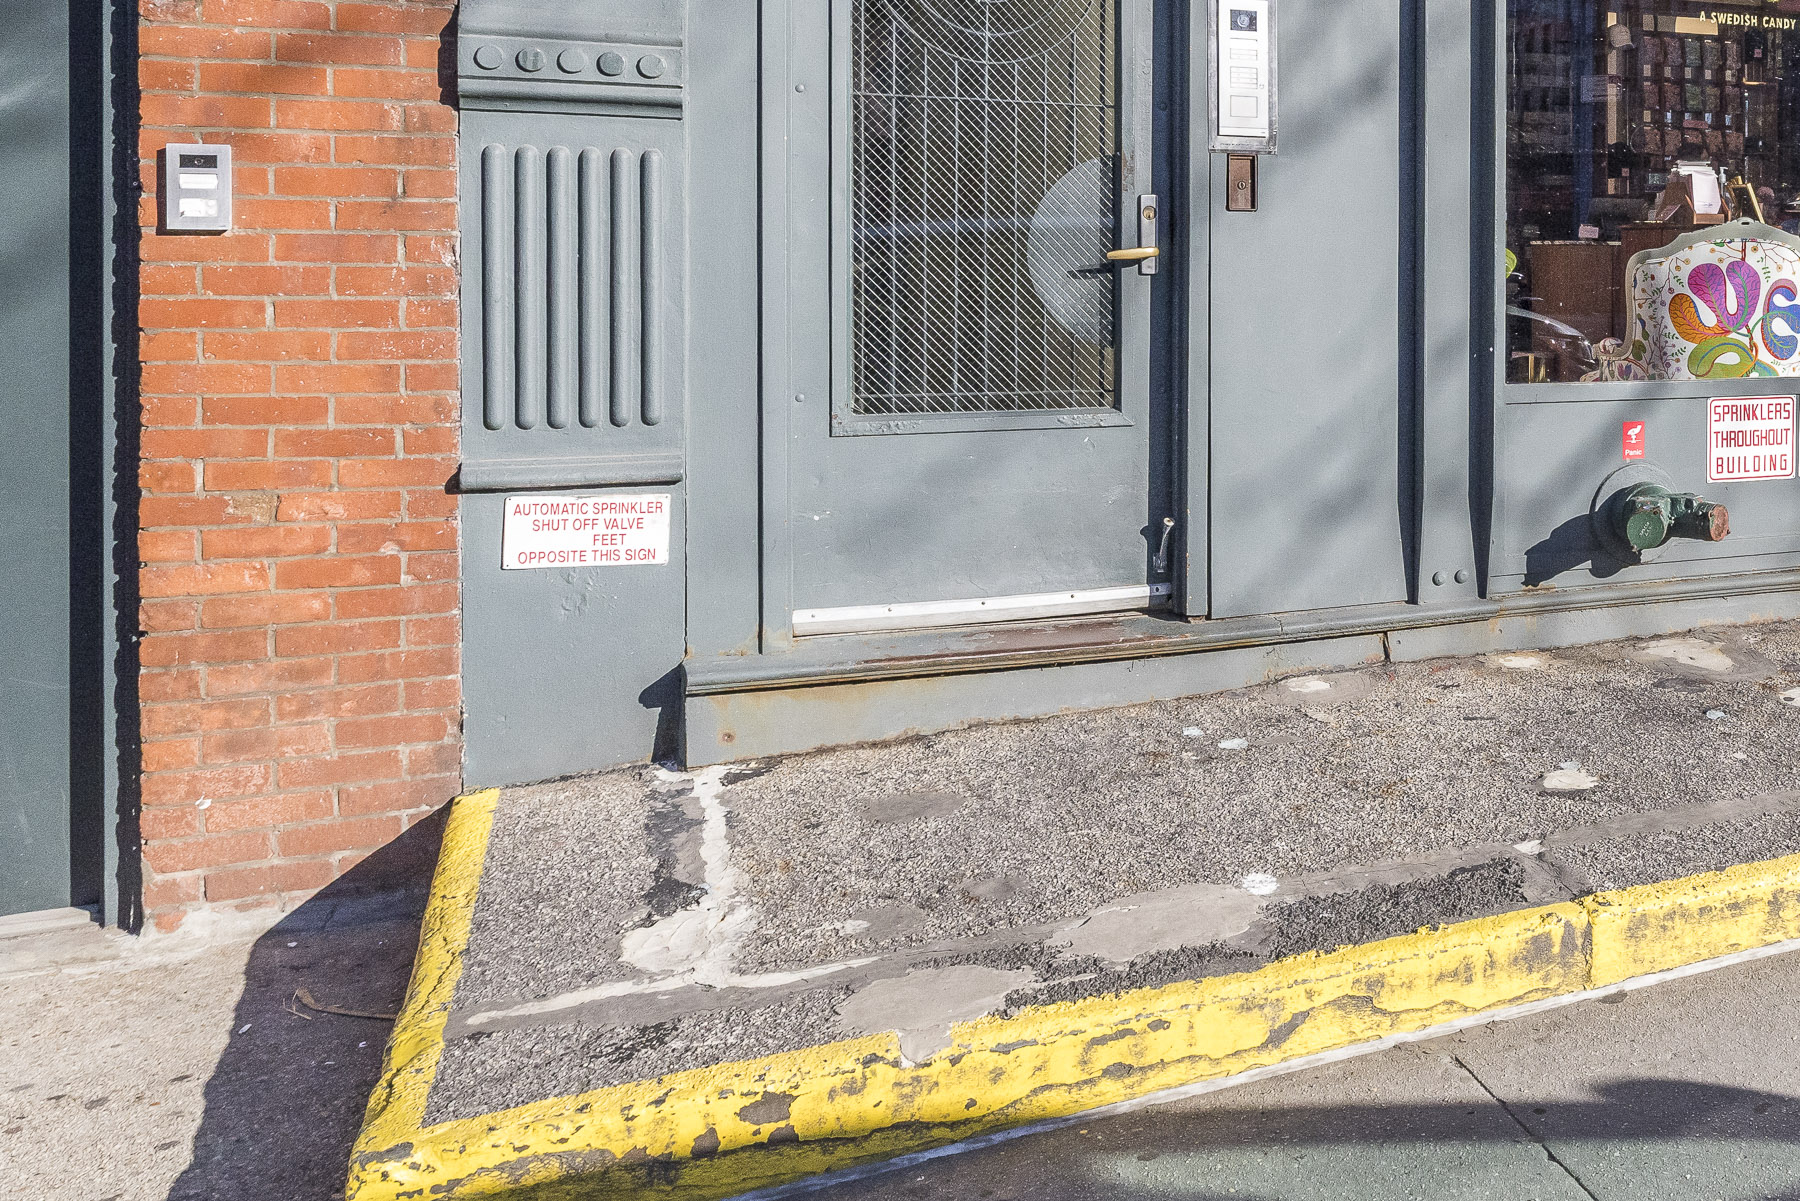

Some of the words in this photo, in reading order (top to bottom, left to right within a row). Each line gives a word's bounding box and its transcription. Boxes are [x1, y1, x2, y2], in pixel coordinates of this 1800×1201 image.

[1700, 10, 1706, 22] A
[1710, 11, 1758, 27] SWEDISH
[1762, 16, 1796, 31] CANDY
[1713, 402, 1791, 422] SPRINKLERS
[1713, 427, 1791, 449] THROUGHOUT
[1624, 448, 1643, 456] Panic
[1716, 453, 1788, 474] BUILDING
[513, 502, 589, 516] AUTOMATIC
[592, 501, 663, 515] SPRINKLER
[532, 519, 569, 532] SHUT
[572, 518, 599, 531] OFF
[603, 517, 644, 530] VALVE
[593, 533, 627, 546] FEET
[517, 550, 587, 565] OPPOSITE
[591, 549, 621, 562] THIS
[625, 548, 656, 561] SIGN
